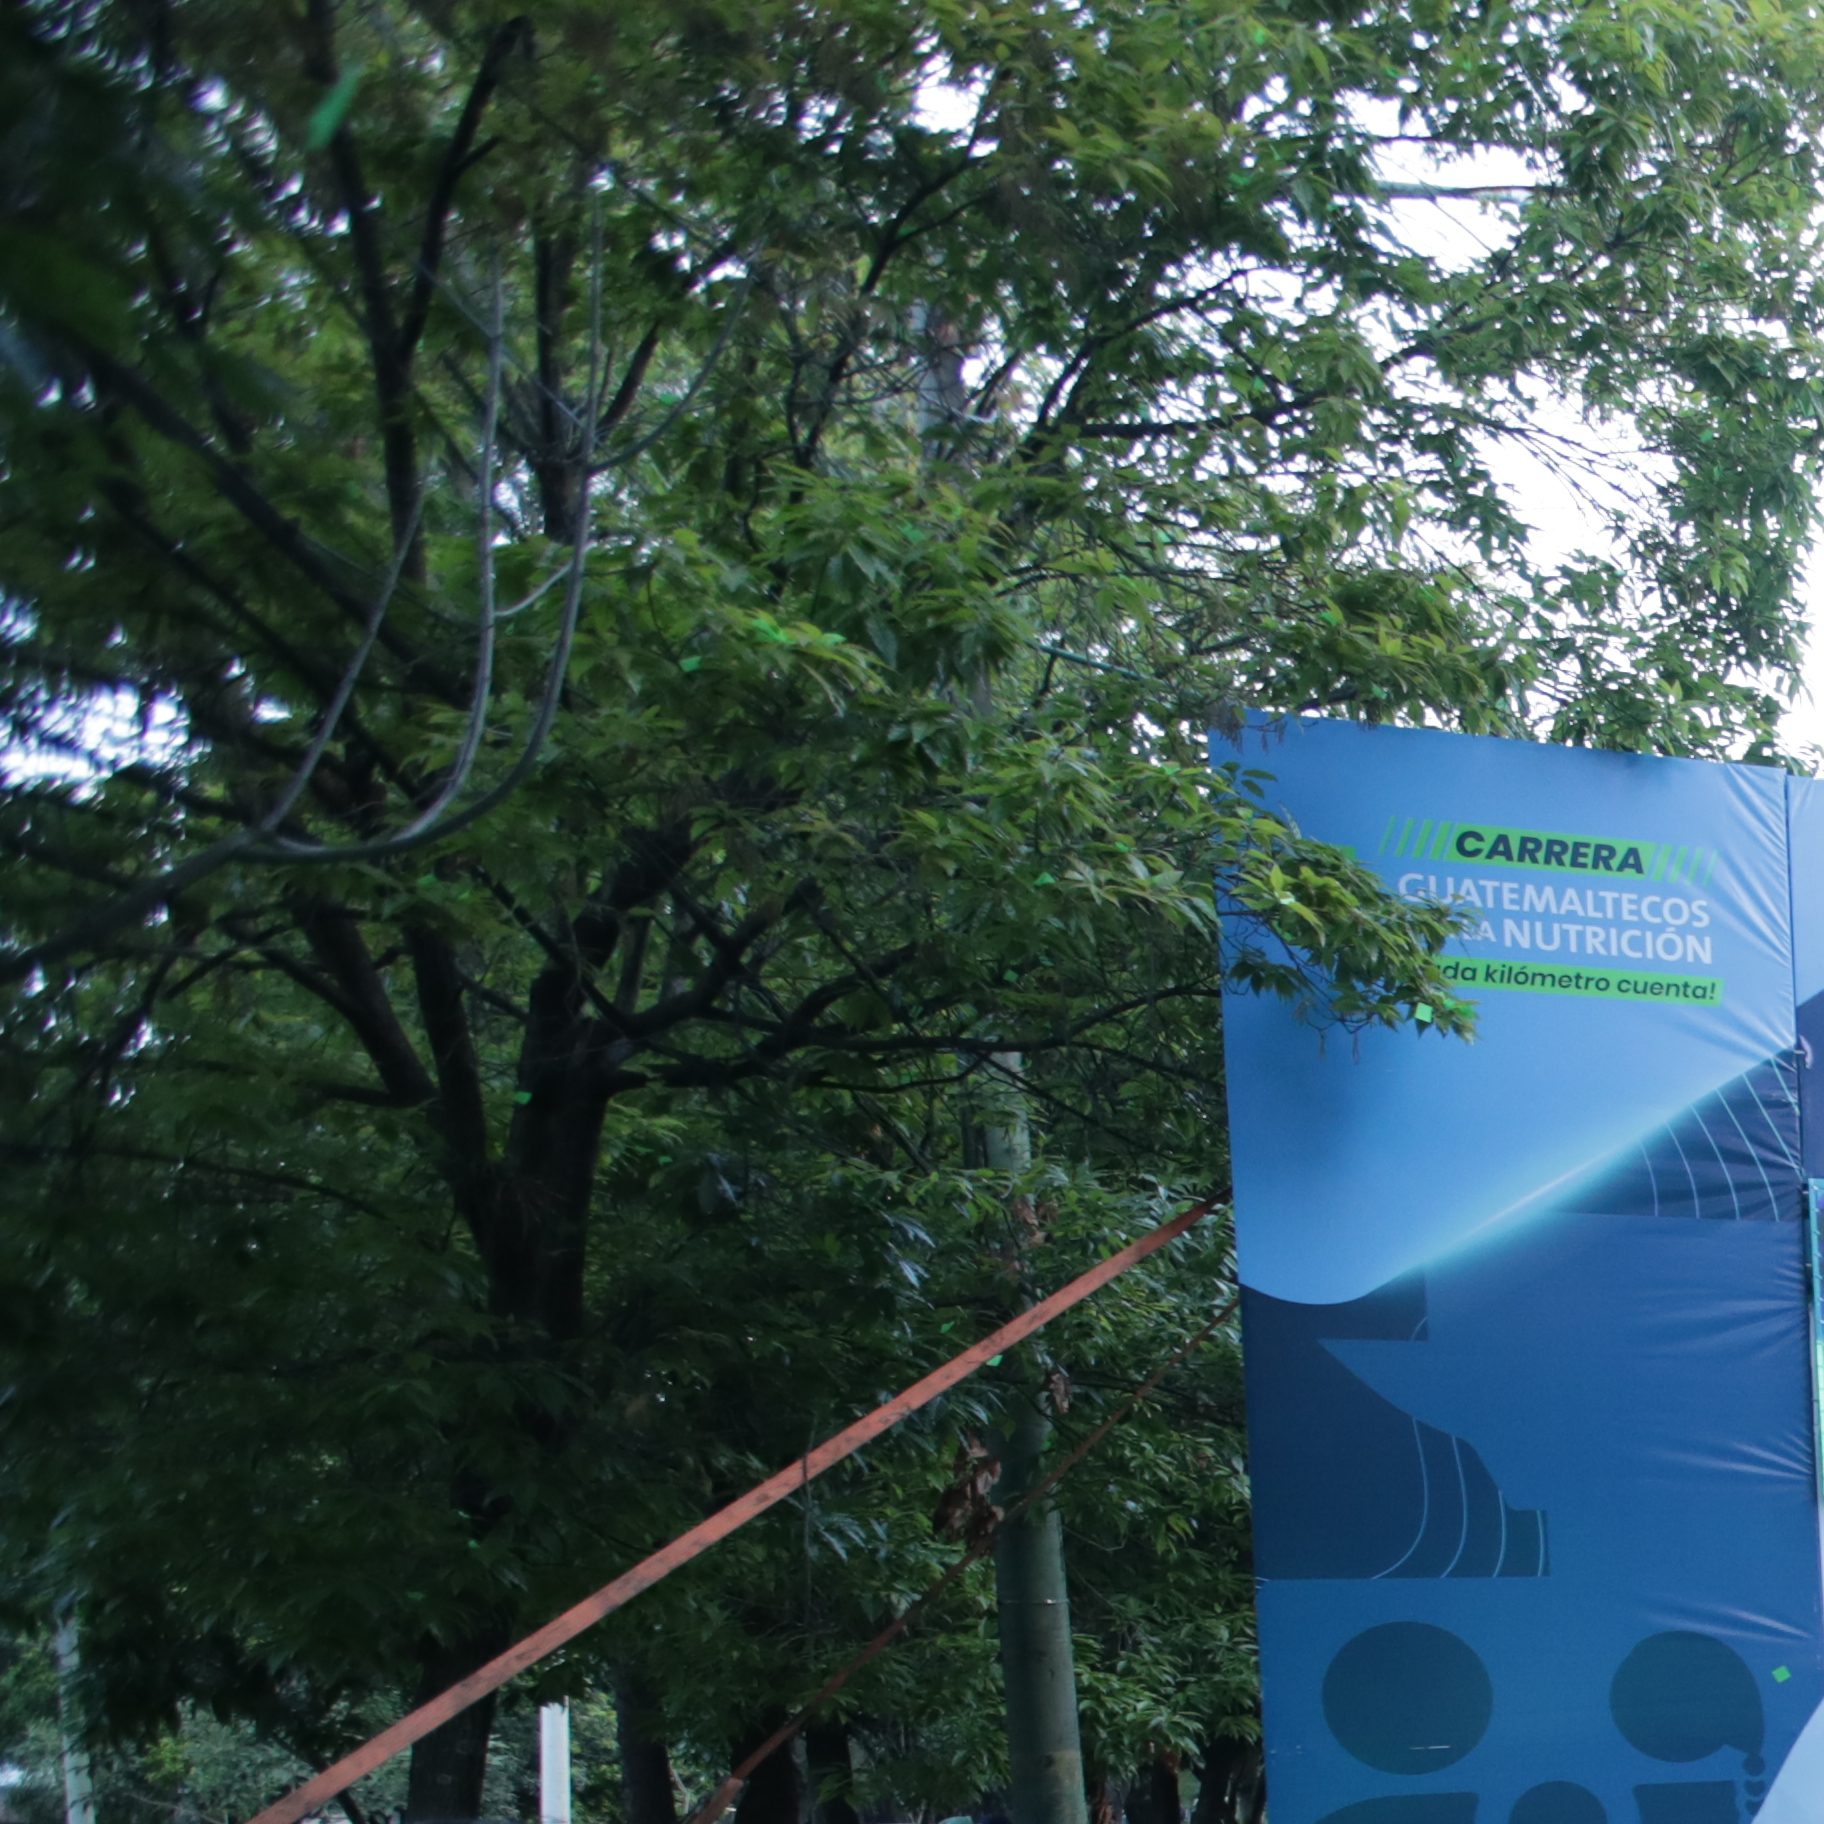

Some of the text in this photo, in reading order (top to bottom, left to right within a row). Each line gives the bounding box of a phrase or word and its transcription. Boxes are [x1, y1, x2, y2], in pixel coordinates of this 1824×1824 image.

[1455, 829, 1645, 875] CARRERA
[1503, 917, 1713, 965] NUTRICIÓN
[1485, 963, 1610, 992] kilómetro
[1617, 977, 1716, 1001] cuenta!
